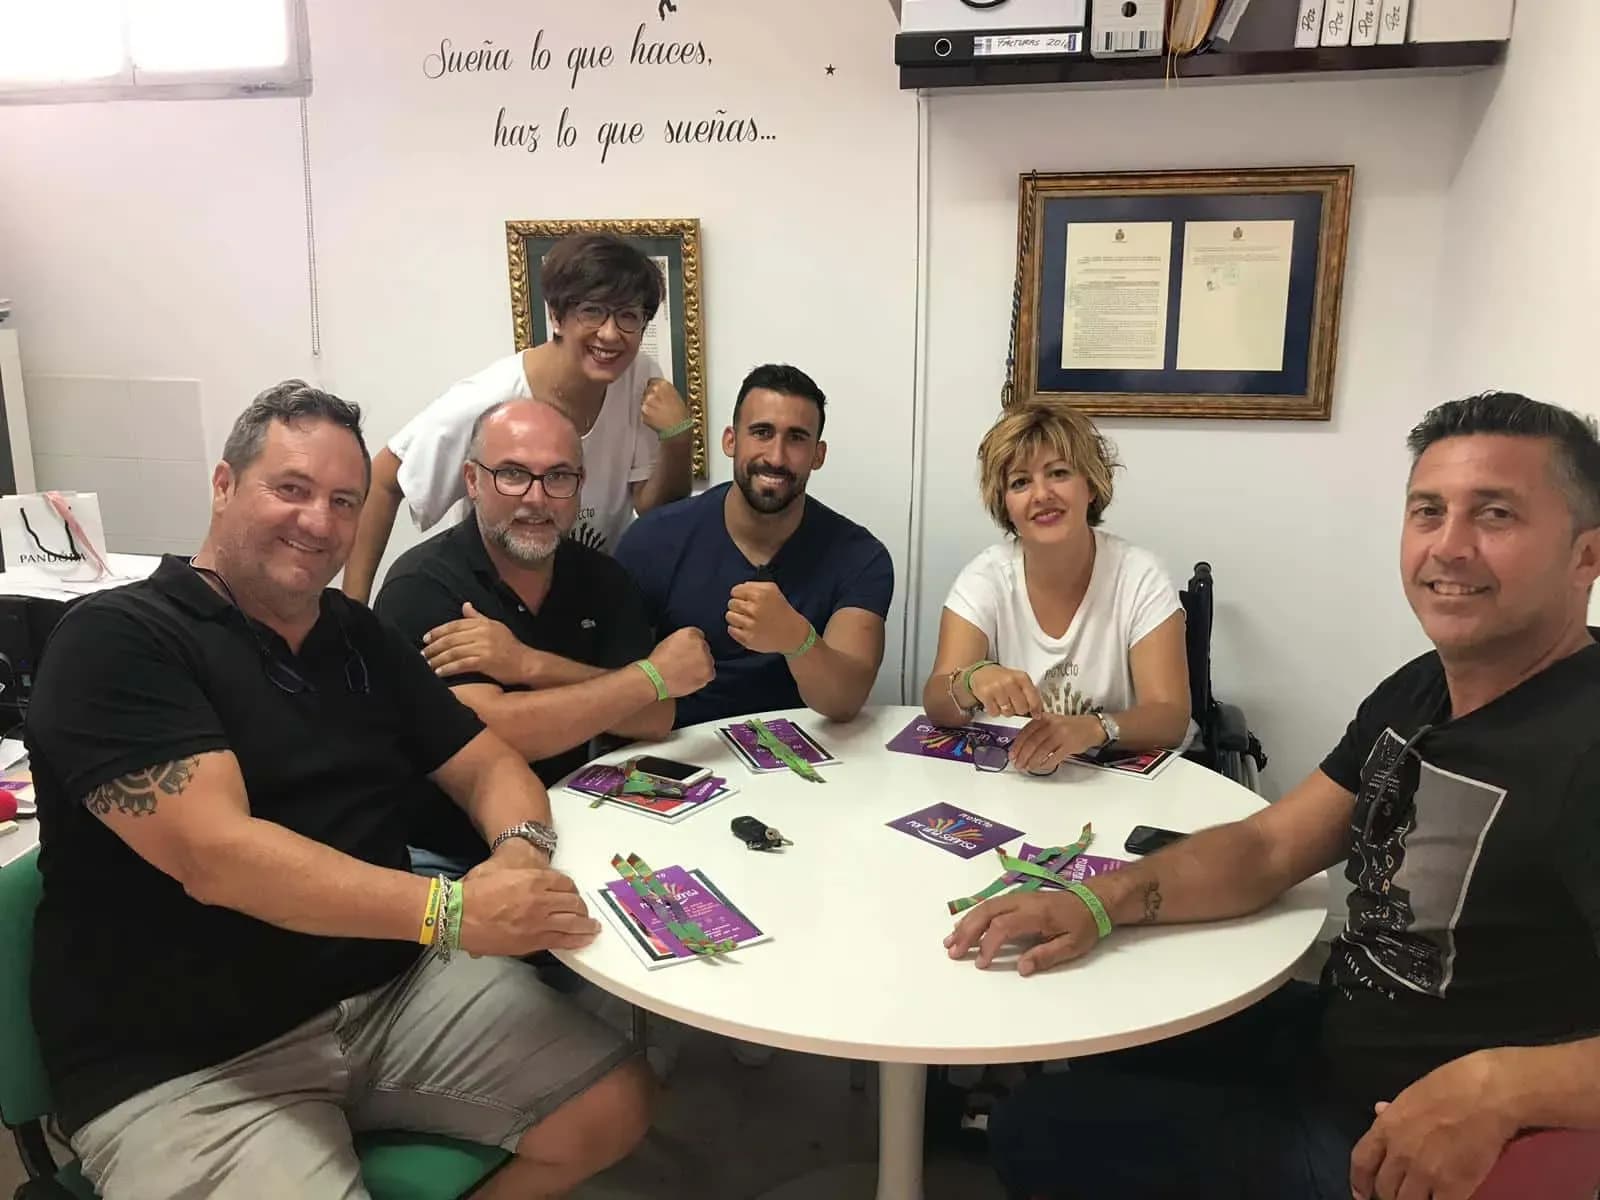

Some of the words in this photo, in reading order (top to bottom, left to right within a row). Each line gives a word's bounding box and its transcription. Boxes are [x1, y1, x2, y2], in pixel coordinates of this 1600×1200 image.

[423, 38, 513, 79] Sueña
[530, 29, 552, 71] lo
[567, 42, 615, 89] que
[630, 23, 713, 68] haces,
[494, 107, 540, 153] haz
[557, 107, 578, 147] lo
[597, 121, 645, 164] que
[664, 110, 777, 145] sueñas...
